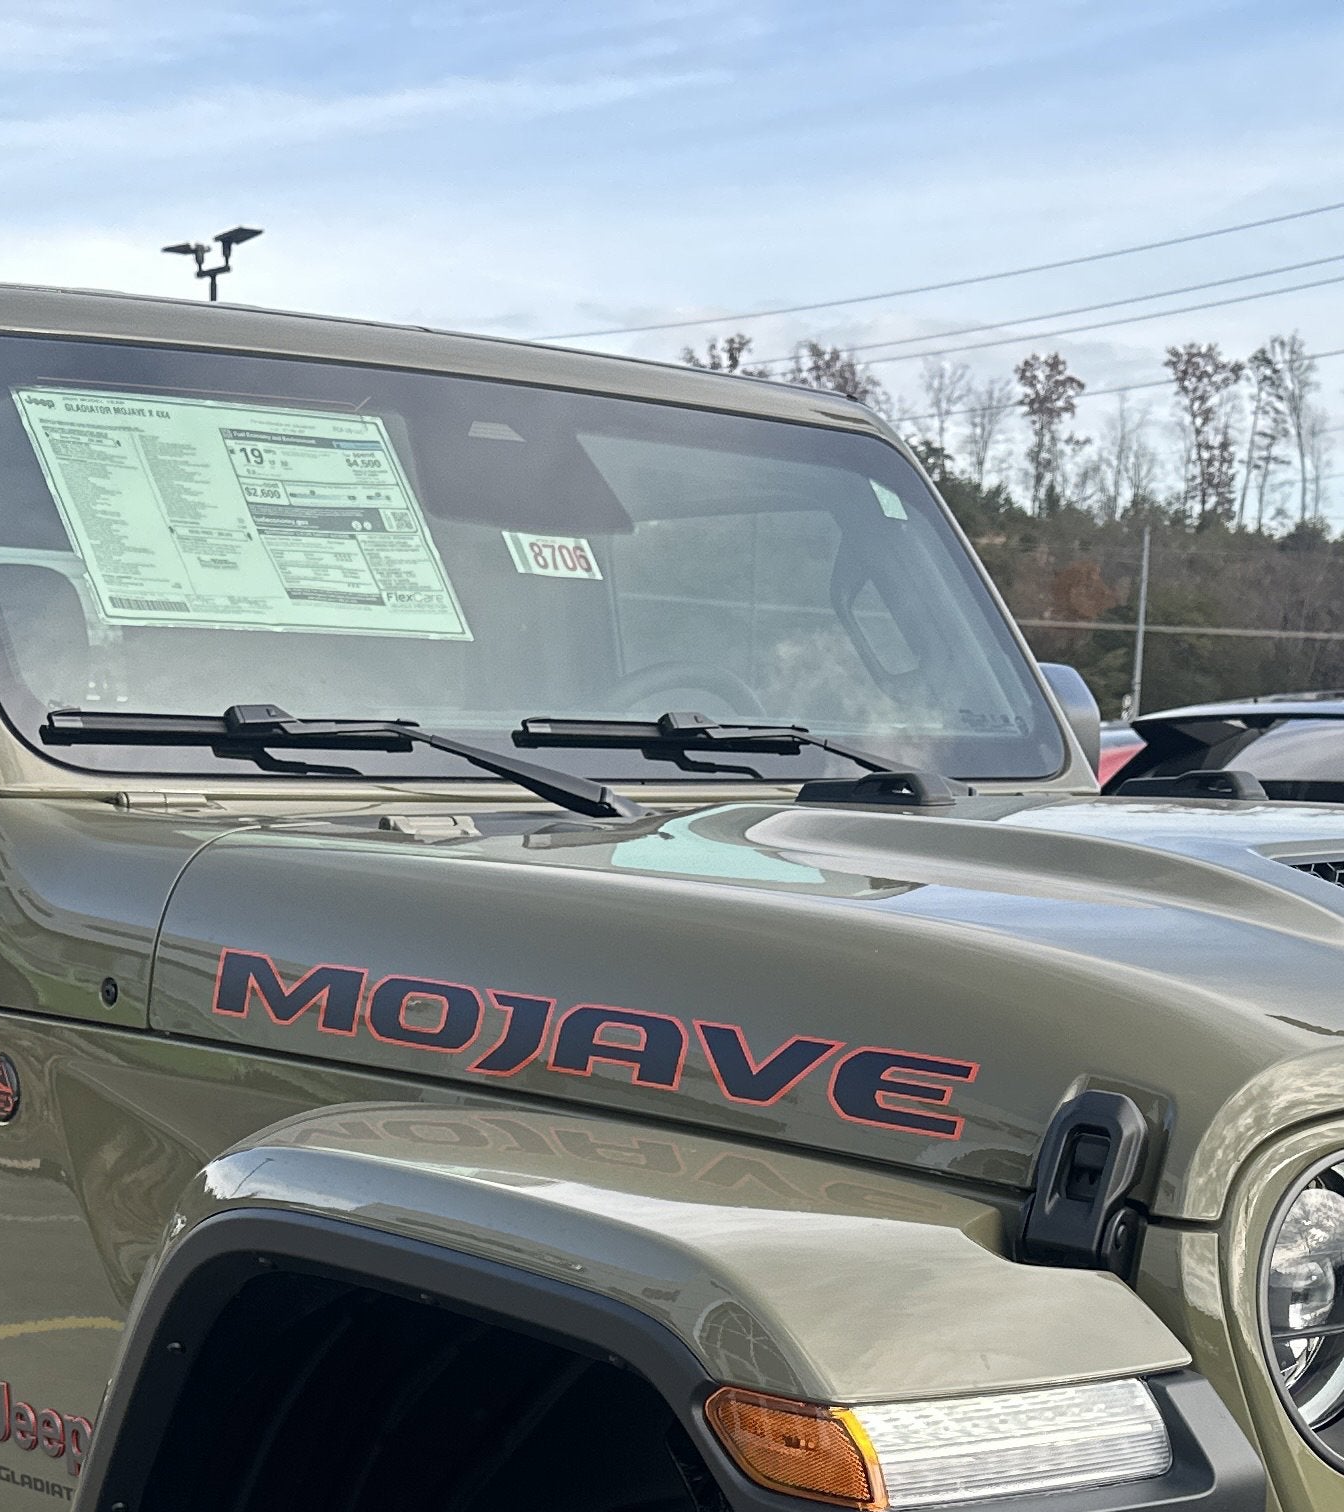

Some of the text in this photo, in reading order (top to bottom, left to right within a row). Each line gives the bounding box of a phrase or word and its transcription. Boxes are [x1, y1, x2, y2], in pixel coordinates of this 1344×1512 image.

[64, 403, 113, 415] GLADIATOR
[114, 406, 146, 417] MOJAVE
[239, 447, 265, 465] 19
[529, 542, 593, 573] 8706
[213, 946, 980, 1141] MOJAVE
